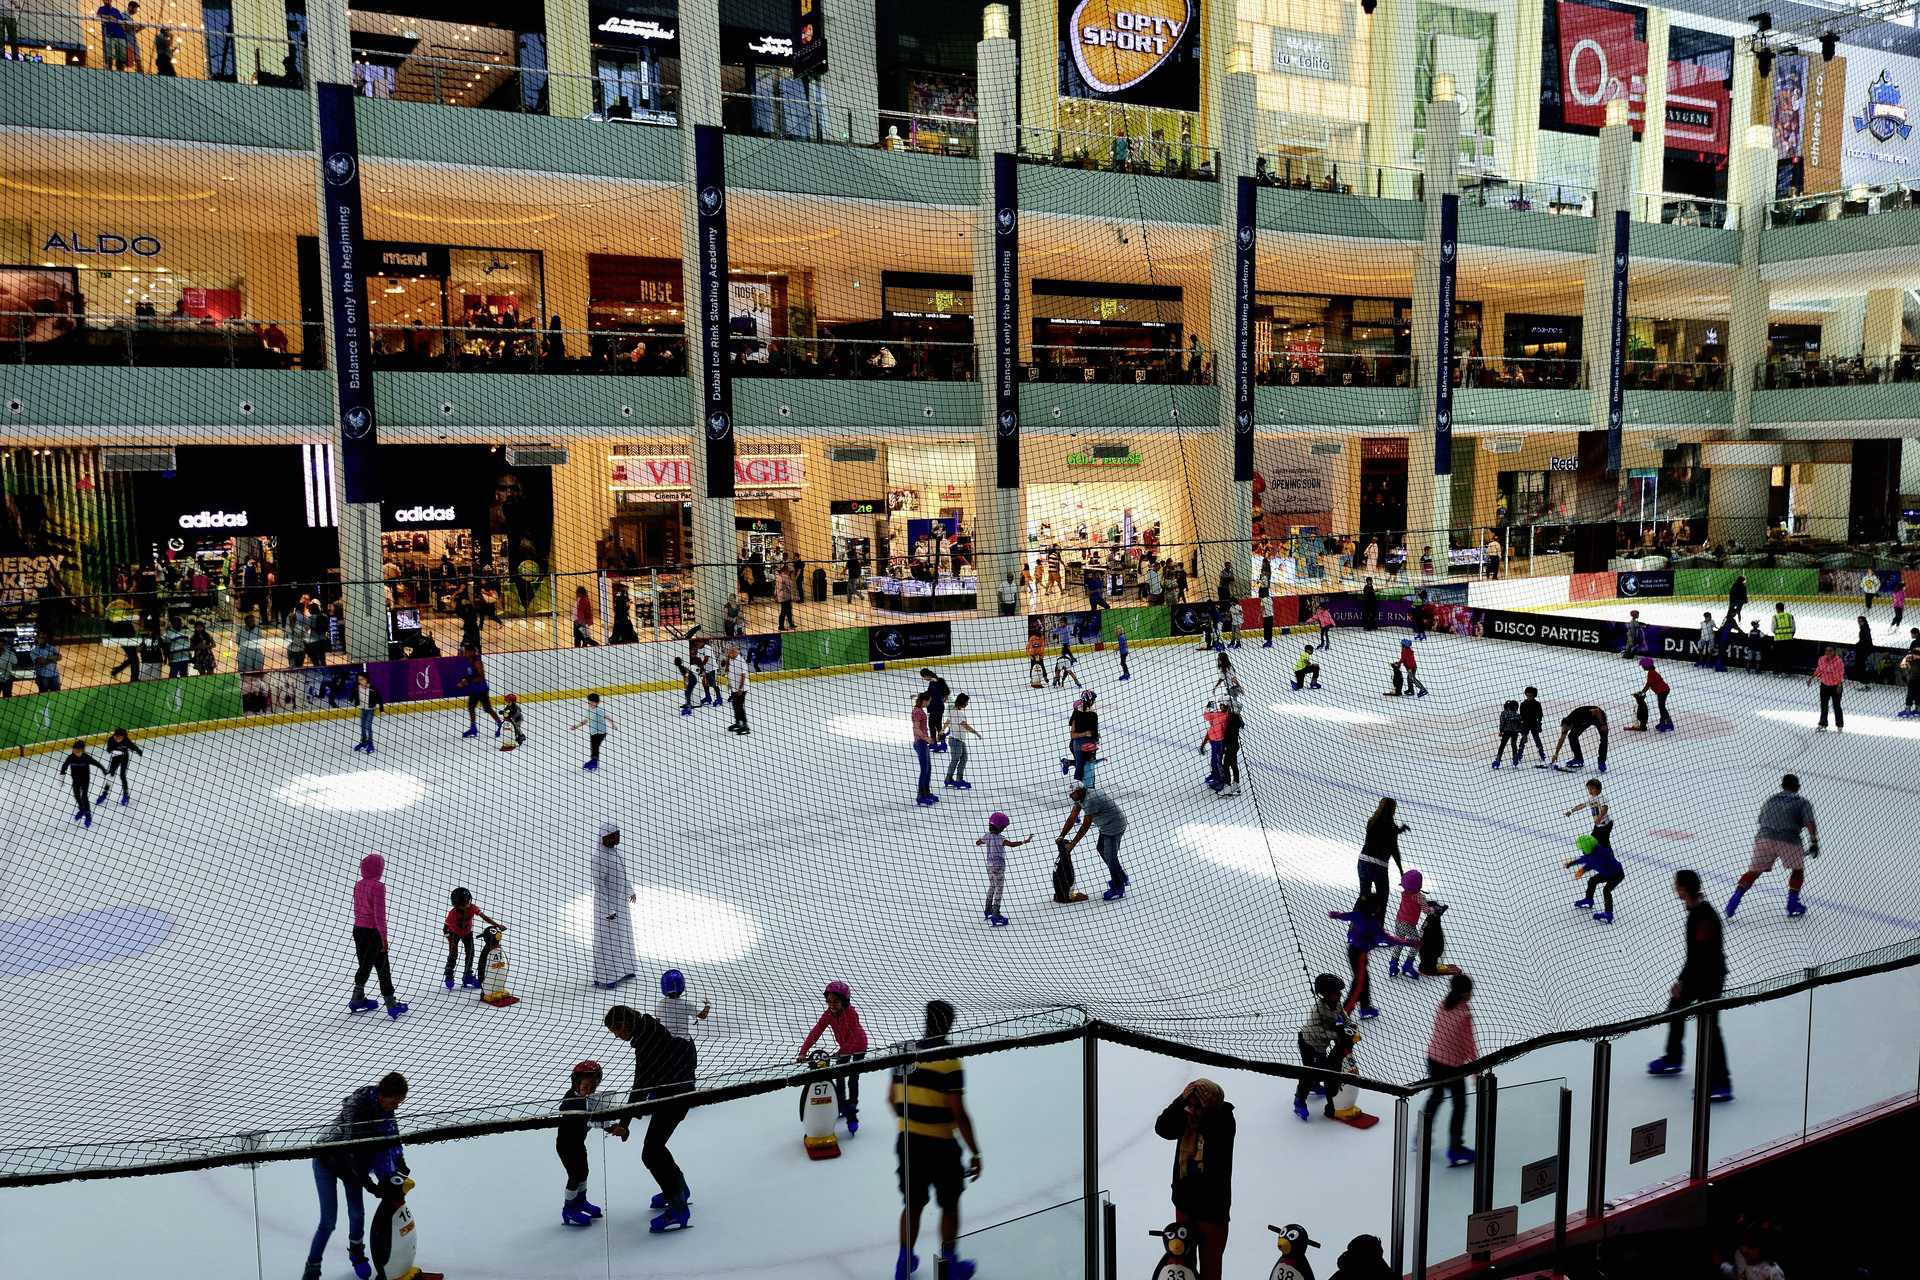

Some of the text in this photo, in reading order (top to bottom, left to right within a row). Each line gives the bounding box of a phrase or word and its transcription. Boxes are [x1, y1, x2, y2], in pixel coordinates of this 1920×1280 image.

[1116, 12, 1182, 37] OPTY
[1083, 26, 1168, 55] SPORT
[1665, 107, 1711, 125] XYGENE
[44, 232, 161, 256] ALDO
[339, 206, 360, 389] Balance is only the beginning
[709, 226, 721, 401] Dubai Ice Rink Skating Academy
[1003, 250, 1011, 397] Balance is only the beginning
[1271, 479, 1301, 490] OPENING
[654, 492, 680, 500] Cinema
[179, 511, 248, 528] adidas
[394, 506, 456, 522] adidas
[1494, 621, 1600, 644] DISCO PARTIES
[1664, 638, 1684, 652] DJ
[1167, 1269, 1185, 1280] 33
[1277, 1267, 1294, 1280] 38
